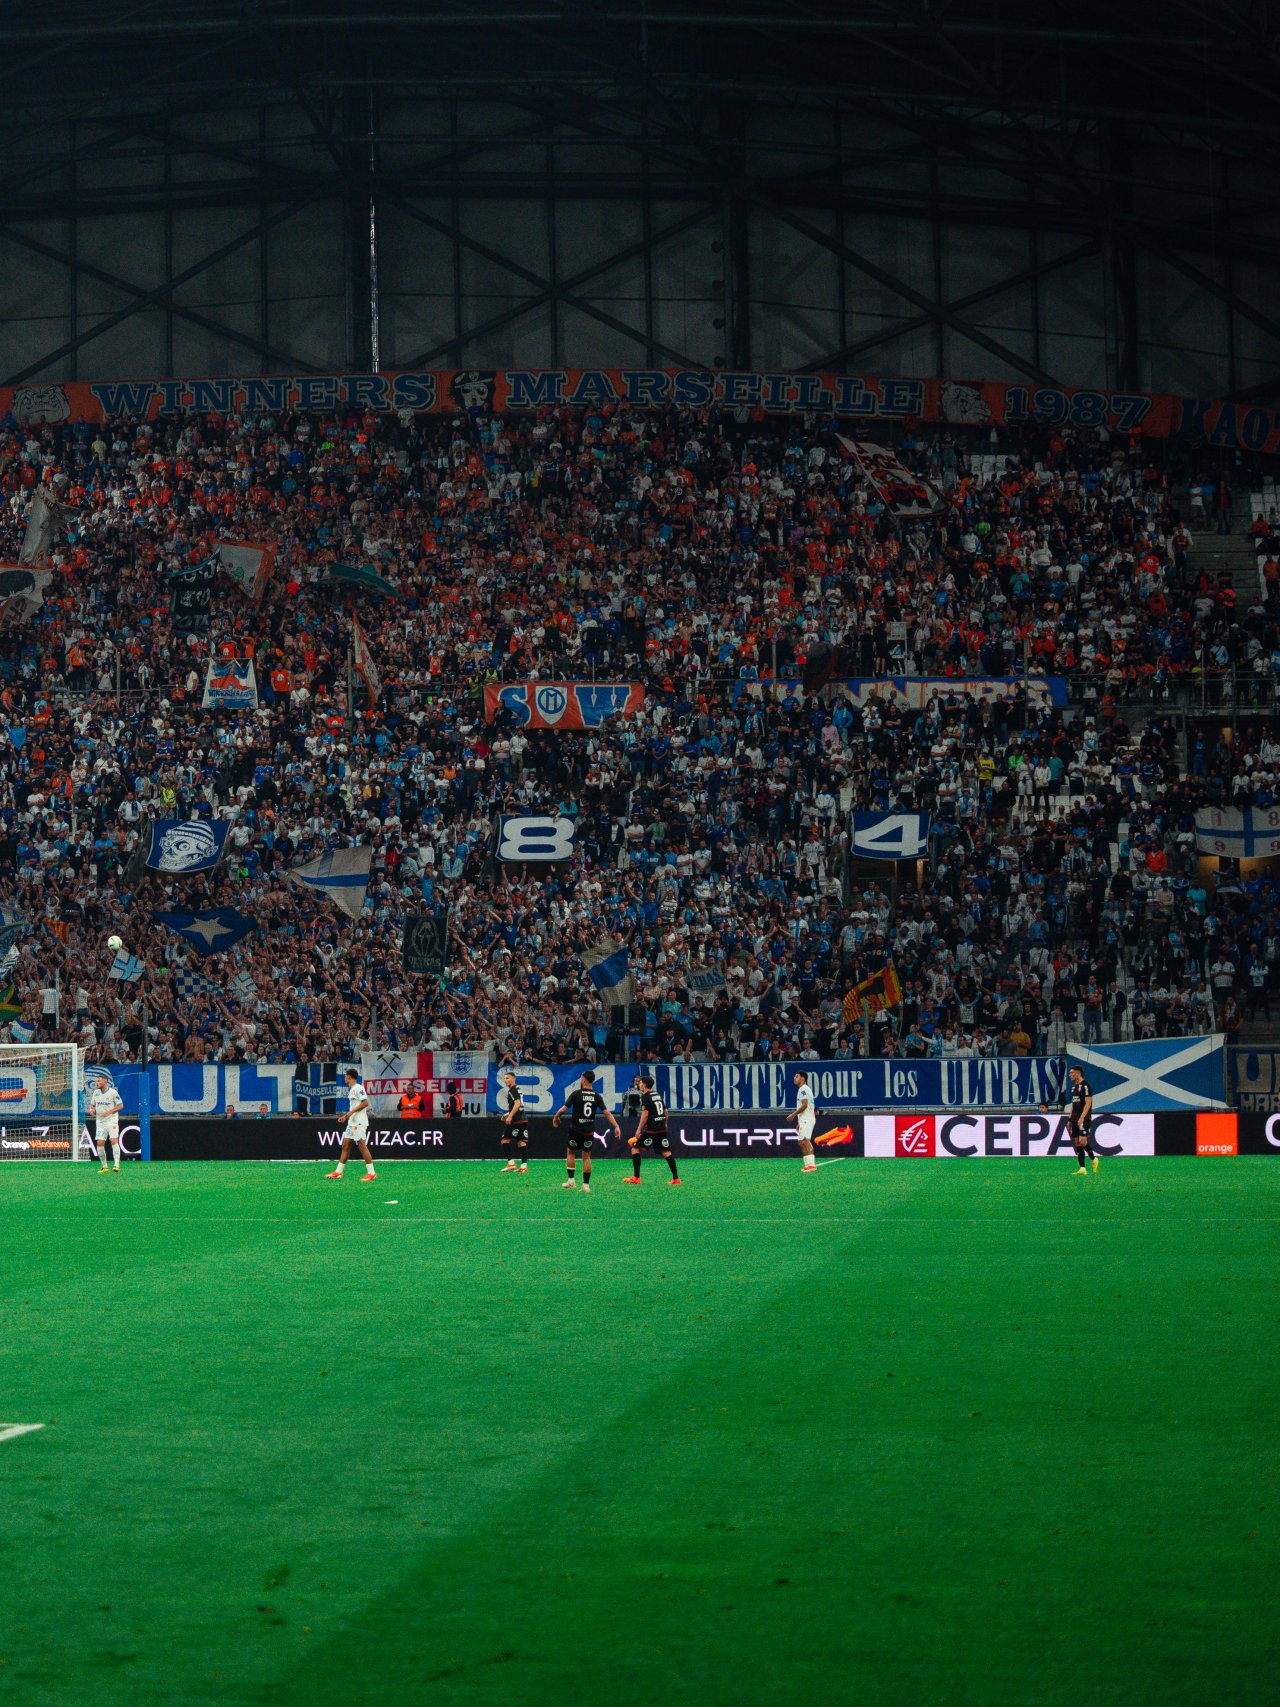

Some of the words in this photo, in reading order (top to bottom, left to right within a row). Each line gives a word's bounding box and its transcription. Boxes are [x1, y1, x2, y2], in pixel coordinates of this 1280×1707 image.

[90, 373, 437, 419] WINNERS
[505, 370, 926, 420] MARSEILLE
[1004, 385, 1151, 430] 1987
[1178, 399, 1280, 454] KAO
[500, 816, 575, 860] 8
[855, 814, 927, 857] 4
[366, 1079, 485, 1093] MARSEILE
[496, 1065, 623, 1113] 84
[884, 1061, 919, 1099] les
[939, 1058, 1061, 1105] ULTRAS
[583, 1102, 592, 1117] 6
[2, 1140, 29, 1151] Orange
[940, 1114, 1124, 1157] CEPAC
[1198, 1144, 1234, 1155] orange
